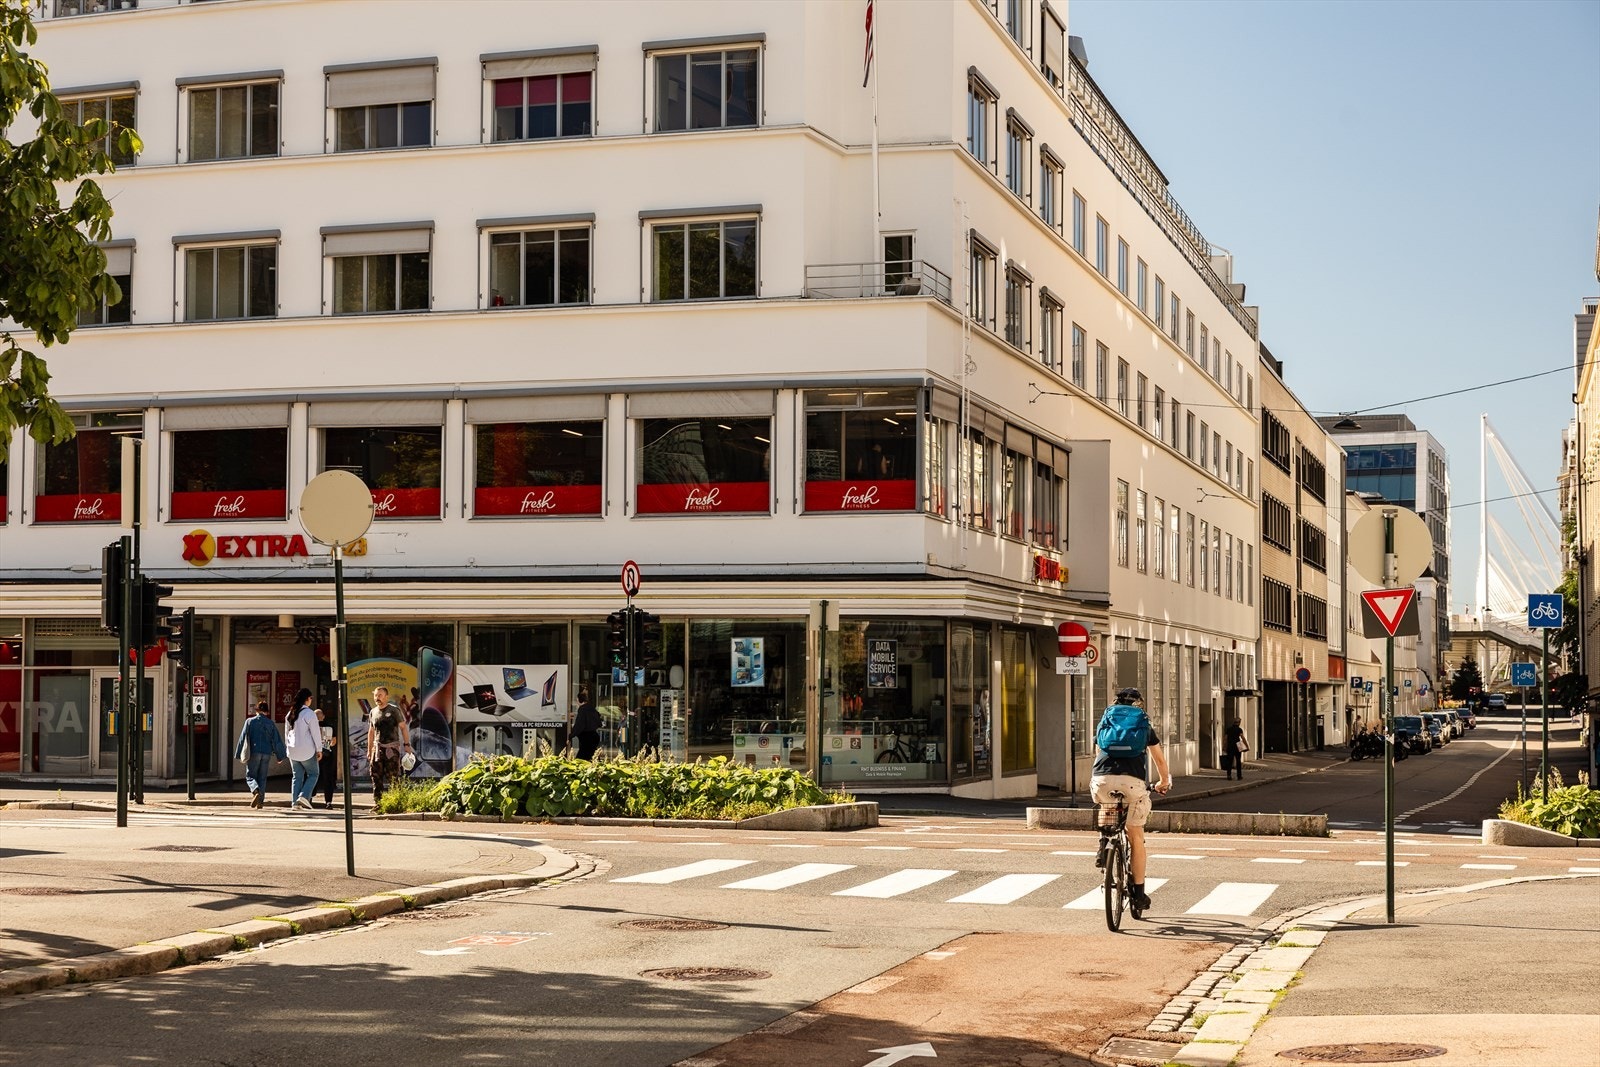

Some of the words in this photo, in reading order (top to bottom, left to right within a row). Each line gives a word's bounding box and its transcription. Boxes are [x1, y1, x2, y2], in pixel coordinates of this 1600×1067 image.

[213, 495, 246, 516] fresh
[372, 493, 396, 512] esh
[520, 491, 555, 513] fresh
[685, 487, 722, 509] fresh
[841, 485, 880, 508] fresh
[73, 498, 104, 519] fresh
[216, 534, 309, 558] EXTRA
[871, 652, 895, 662] MOBILE
[876, 642, 890, 651] DATA
[870, 664, 896, 674] SERVICE
